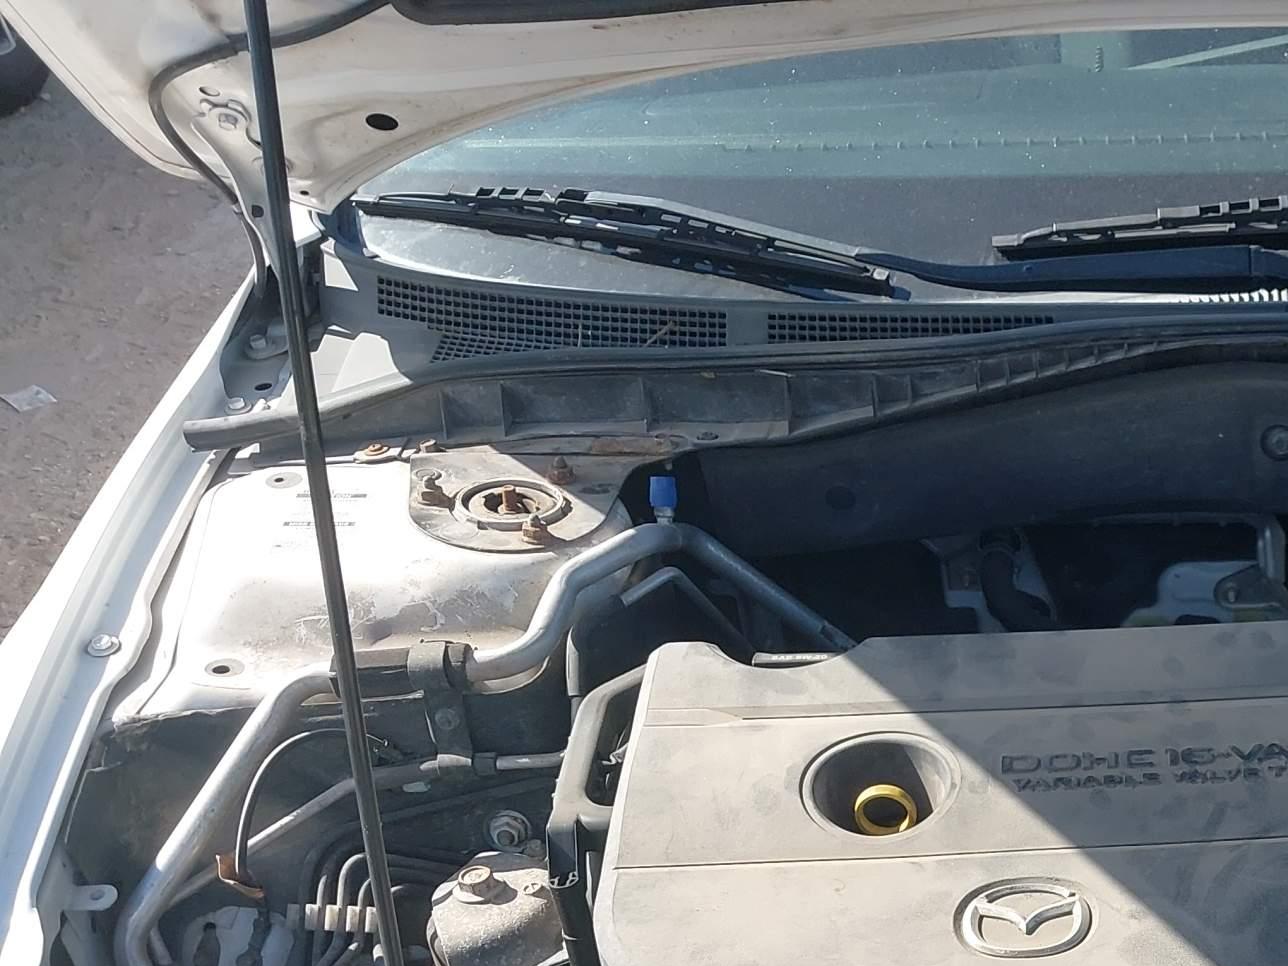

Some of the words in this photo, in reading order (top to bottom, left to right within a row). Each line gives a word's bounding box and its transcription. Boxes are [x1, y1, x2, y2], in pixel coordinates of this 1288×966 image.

[1001, 749, 1156, 773] DOHC
[1013, 773, 1162, 792] VARIABLE
[1175, 767, 1262, 784] VALVE
